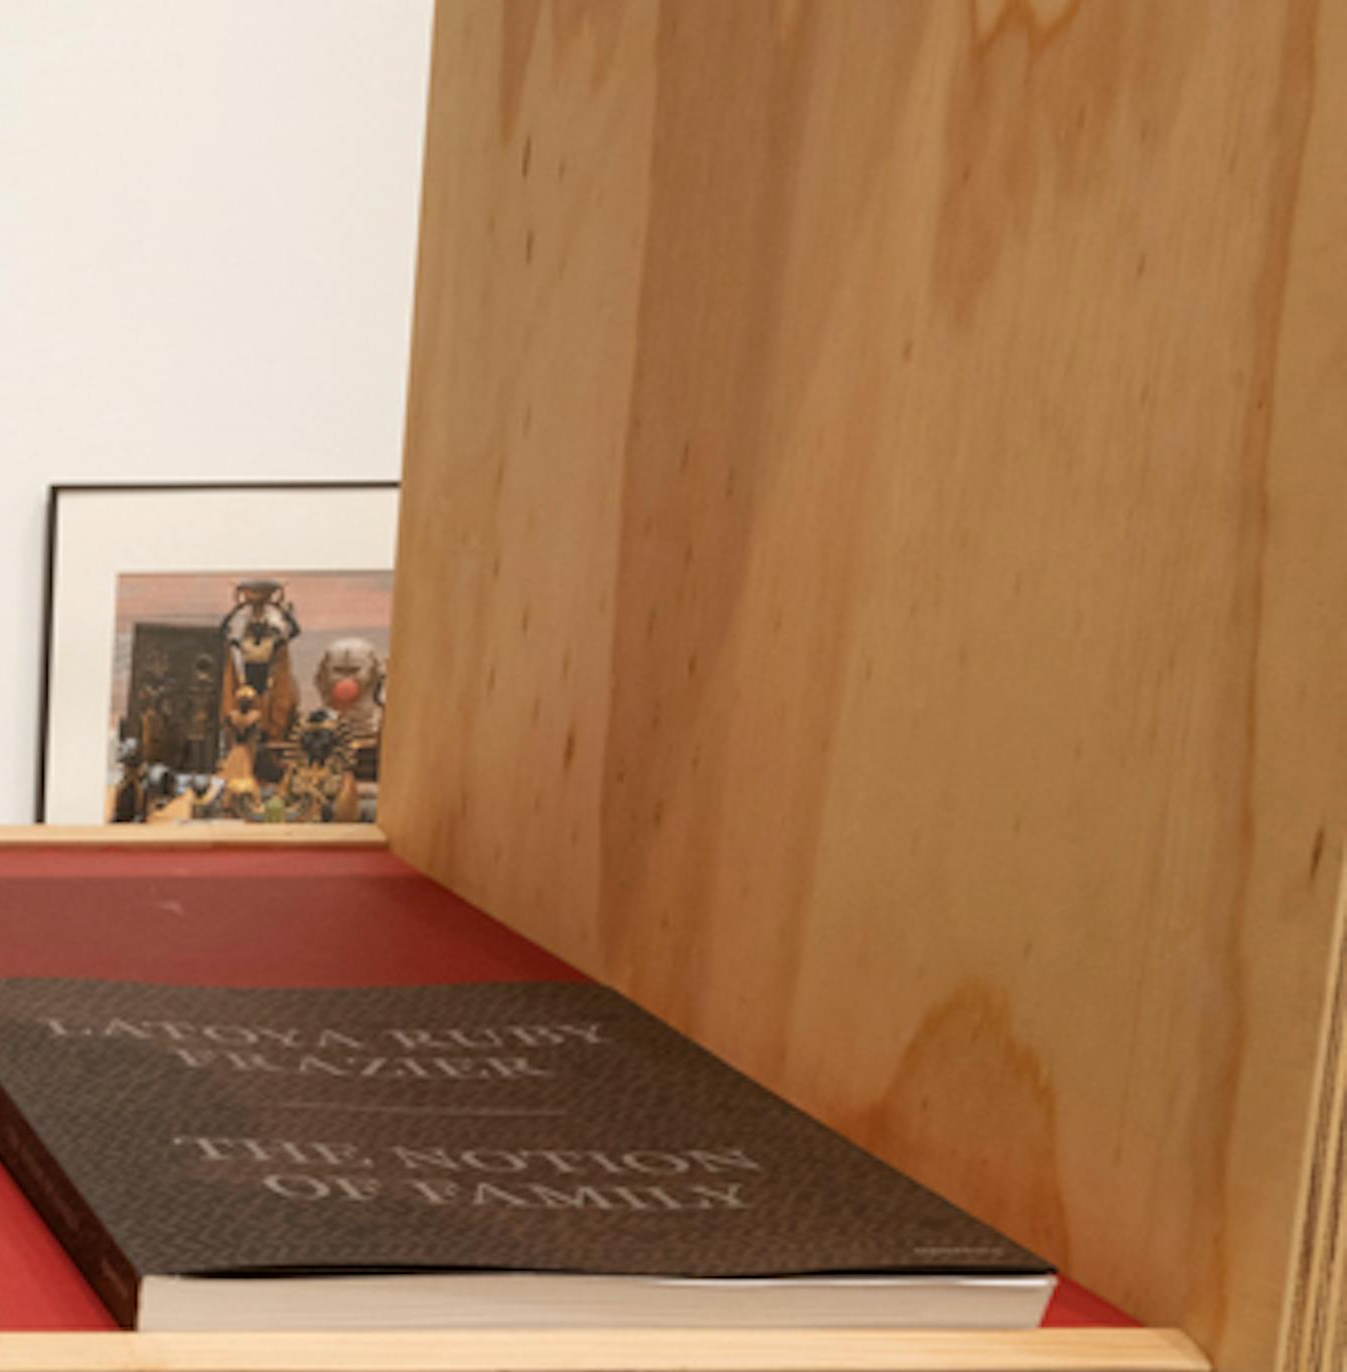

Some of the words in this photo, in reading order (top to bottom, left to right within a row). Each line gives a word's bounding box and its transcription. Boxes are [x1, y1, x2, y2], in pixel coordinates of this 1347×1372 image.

[36, 1017, 363, 1049] LATOYA
[386, 1022, 607, 1048] RUBY
[171, 1046, 552, 1077] FRAZIER
[171, 1136, 375, 1167] THE
[390, 1145, 763, 1174] NOTION
[262, 1173, 383, 1201] OF
[412, 1178, 748, 1211] FAMILY
